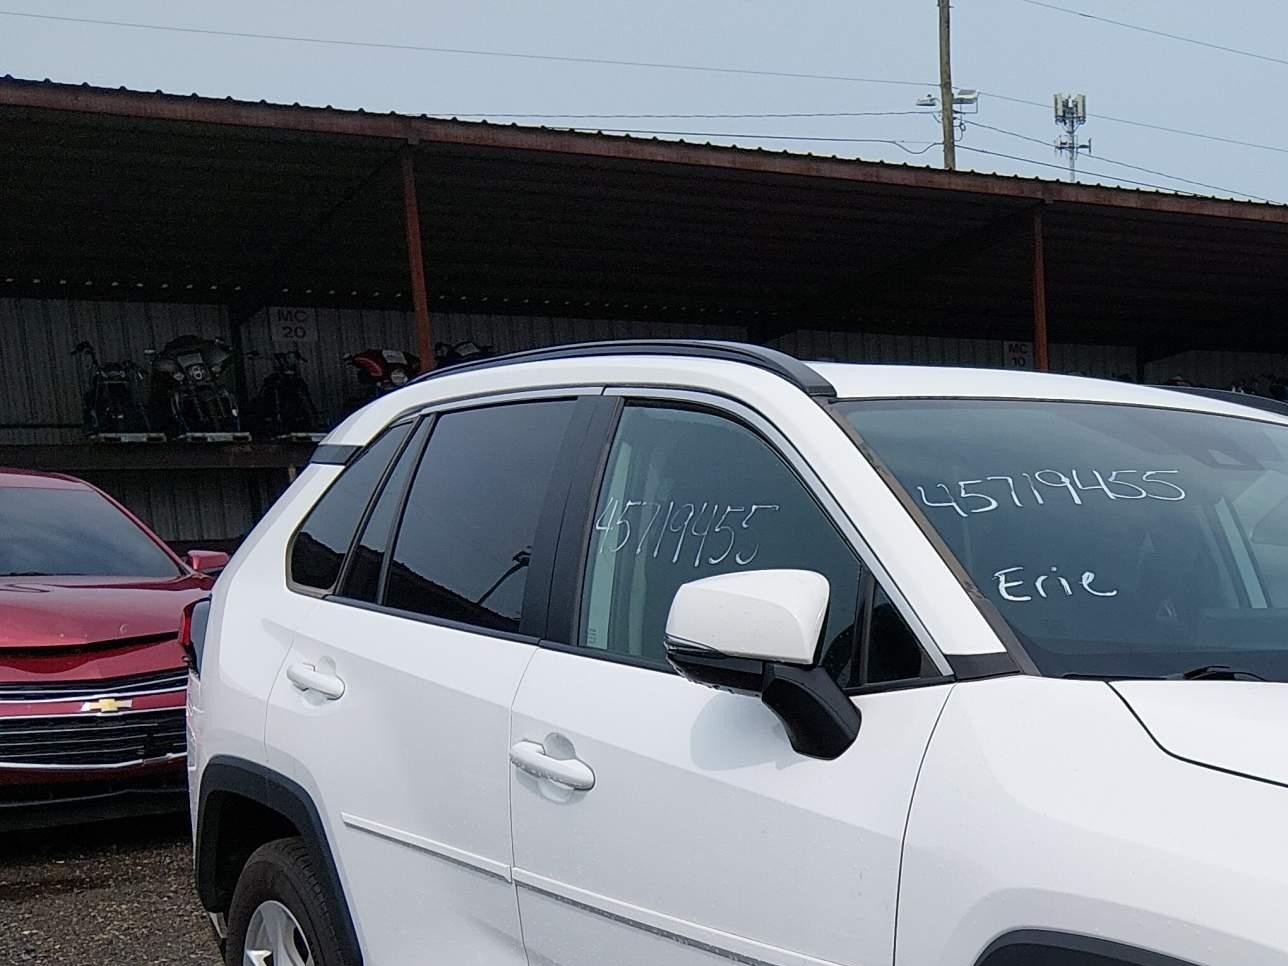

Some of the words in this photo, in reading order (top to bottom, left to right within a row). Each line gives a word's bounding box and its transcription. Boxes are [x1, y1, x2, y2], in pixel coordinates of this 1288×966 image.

[278, 309, 307, 323] MC
[282, 326, 306, 339] 20
[916, 469, 1186, 517] 45719455
[595, 497, 779, 567] 45719455
[992, 566, 1118, 601] Erie
